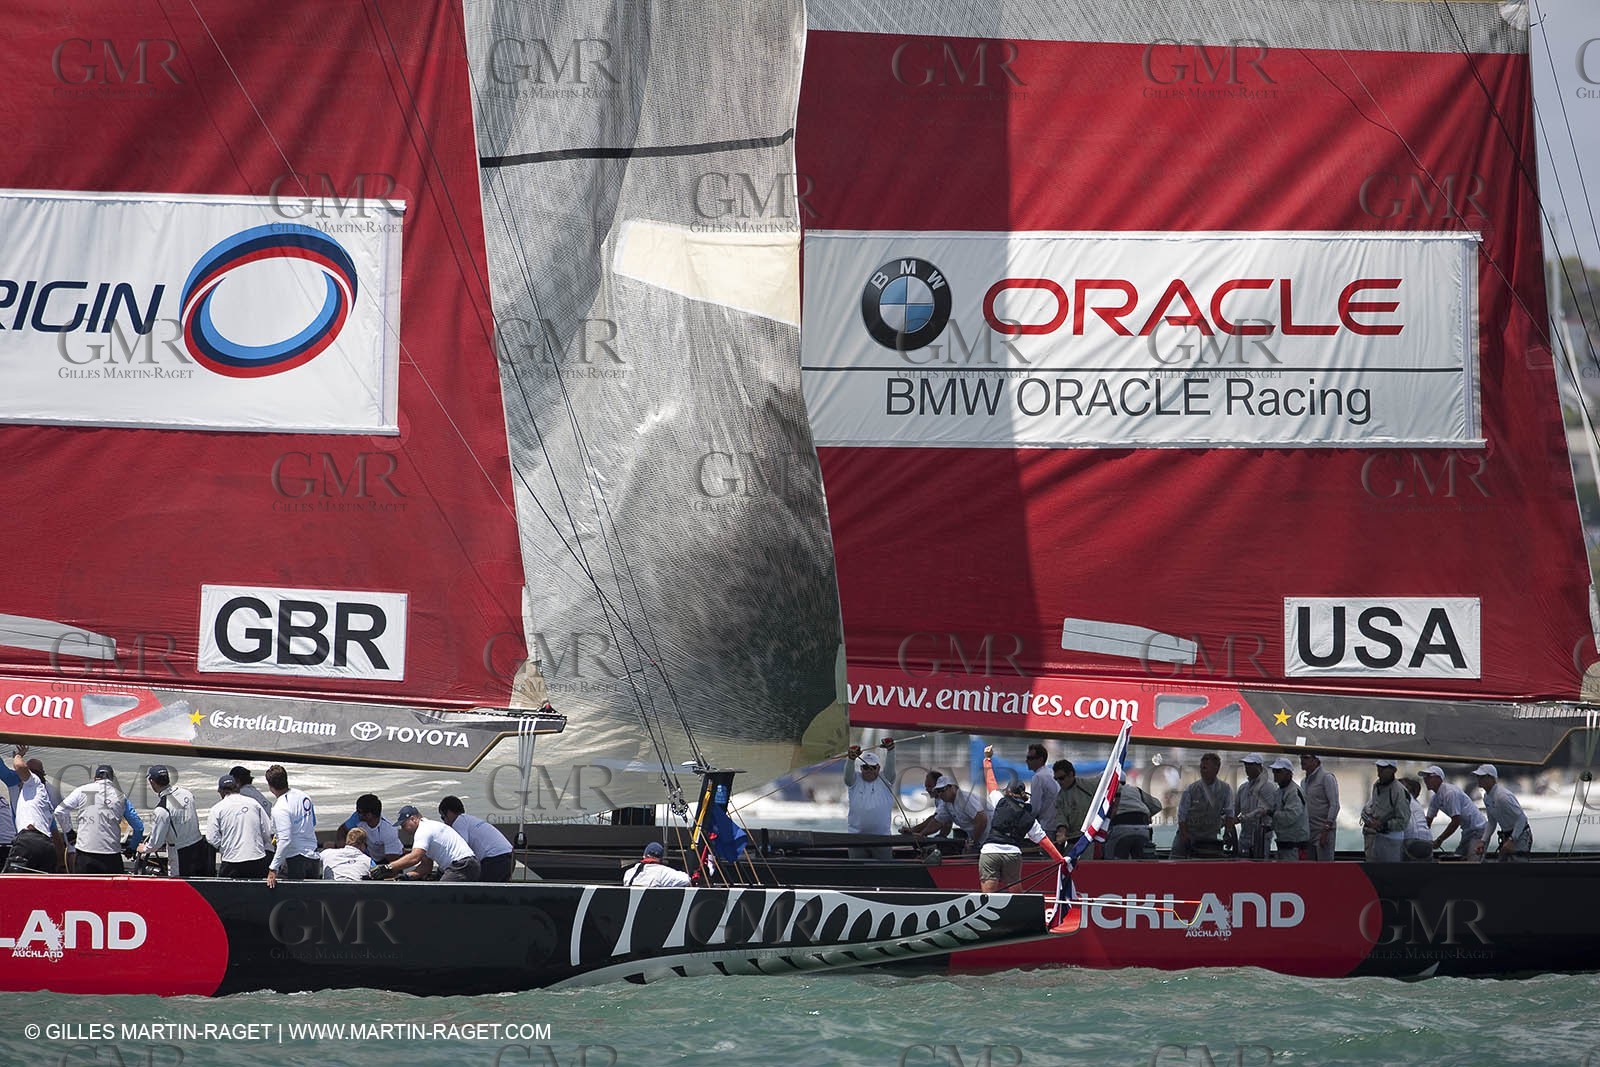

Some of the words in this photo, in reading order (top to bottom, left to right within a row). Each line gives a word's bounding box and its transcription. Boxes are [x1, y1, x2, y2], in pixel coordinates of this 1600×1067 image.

[871, 260, 946, 290] BMW
[982, 277, 1404, 337] ORACLE
[886, 377, 1004, 416] BMW
[1017, 377, 1211, 416] ORACLE
[1226, 378, 1371, 425] Racing
[214, 596, 390, 670] GBR
[1297, 606, 1468, 669] USA
[847, 683, 1139, 722] www.emirates.com
[386, 726, 469, 748] TOYOTA
[1185, 930, 1232, 938] AUCKLAND
[12, 950, 64, 958] AUCKLAND
